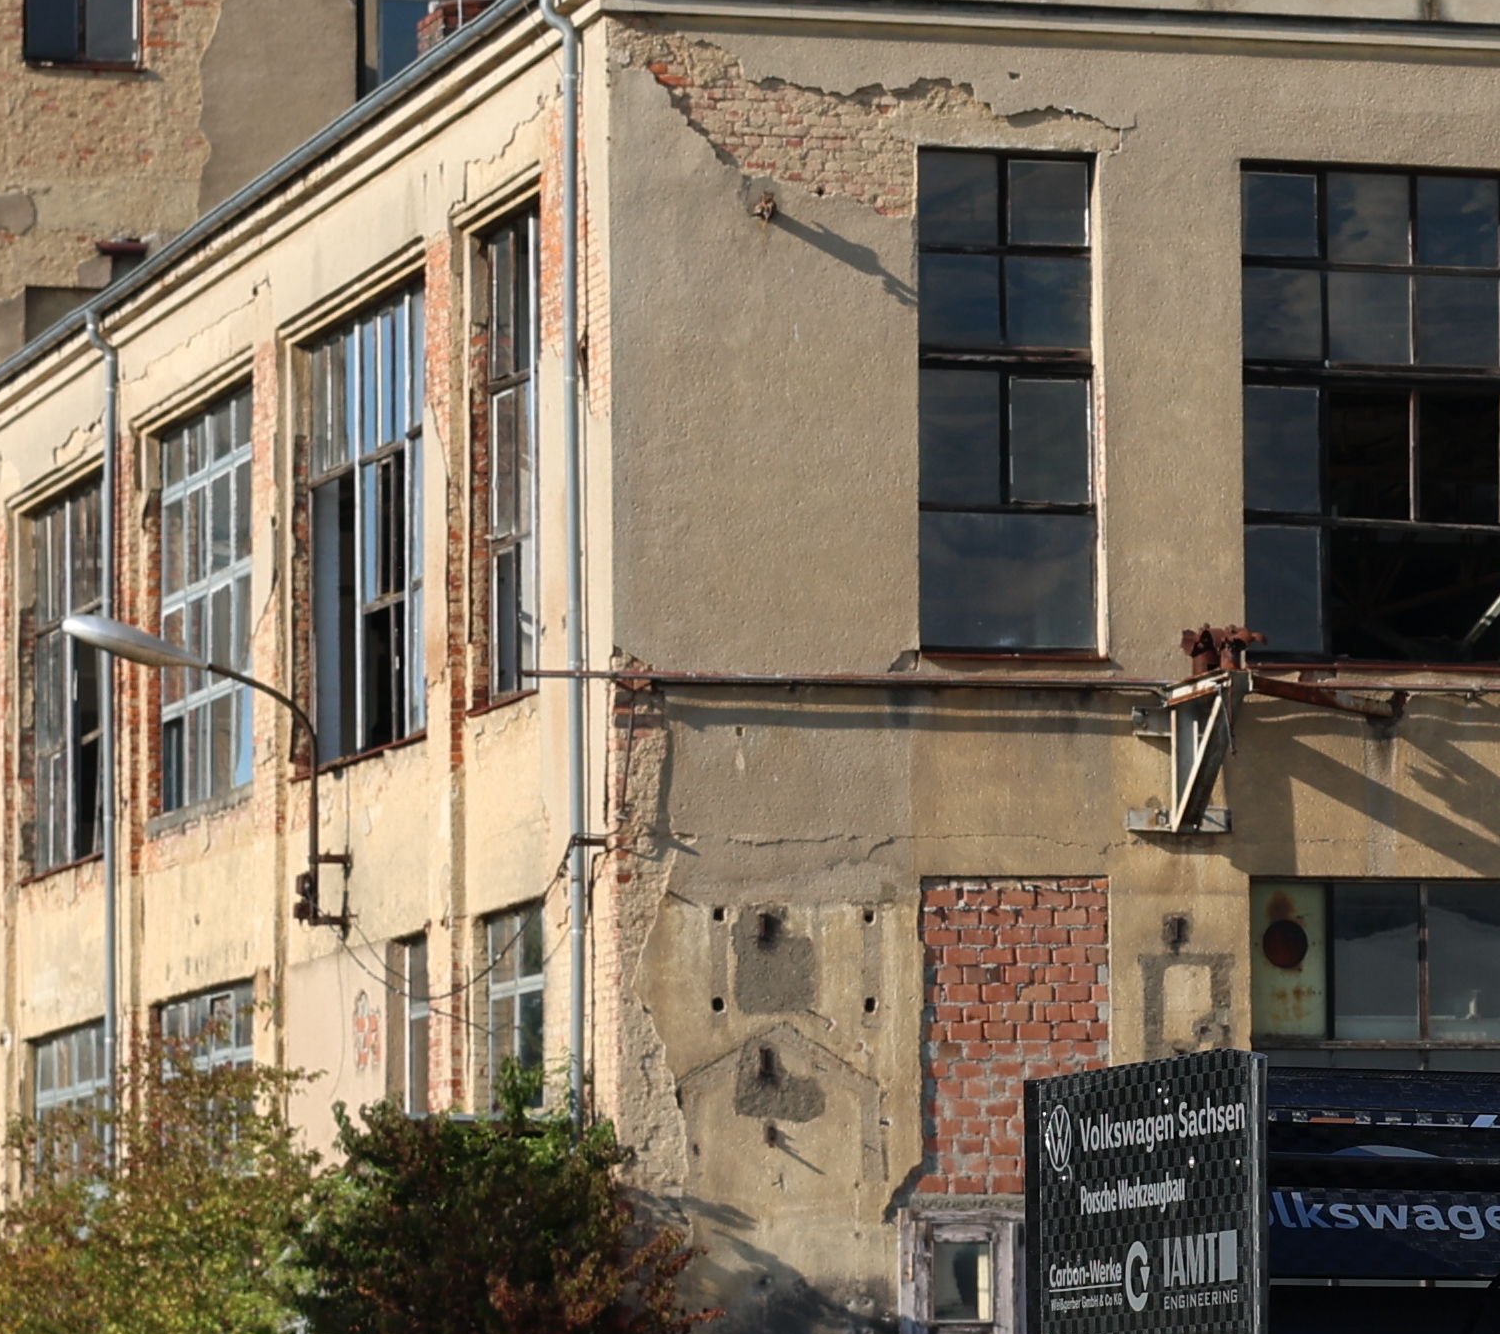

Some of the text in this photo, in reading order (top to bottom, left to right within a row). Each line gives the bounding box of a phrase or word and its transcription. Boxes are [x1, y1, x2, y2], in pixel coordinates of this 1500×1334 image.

[1080, 1097, 1246, 1153] Volkswagen Sachsen
[1080, 1171, 1185, 1215] Porsche Werkzeugbau
[1049, 1257, 1122, 1288] Carbon-Werke
[1163, 1232, 1218, 1288] IAMT
[1163, 1289, 1238, 1310] ENGINEERING
